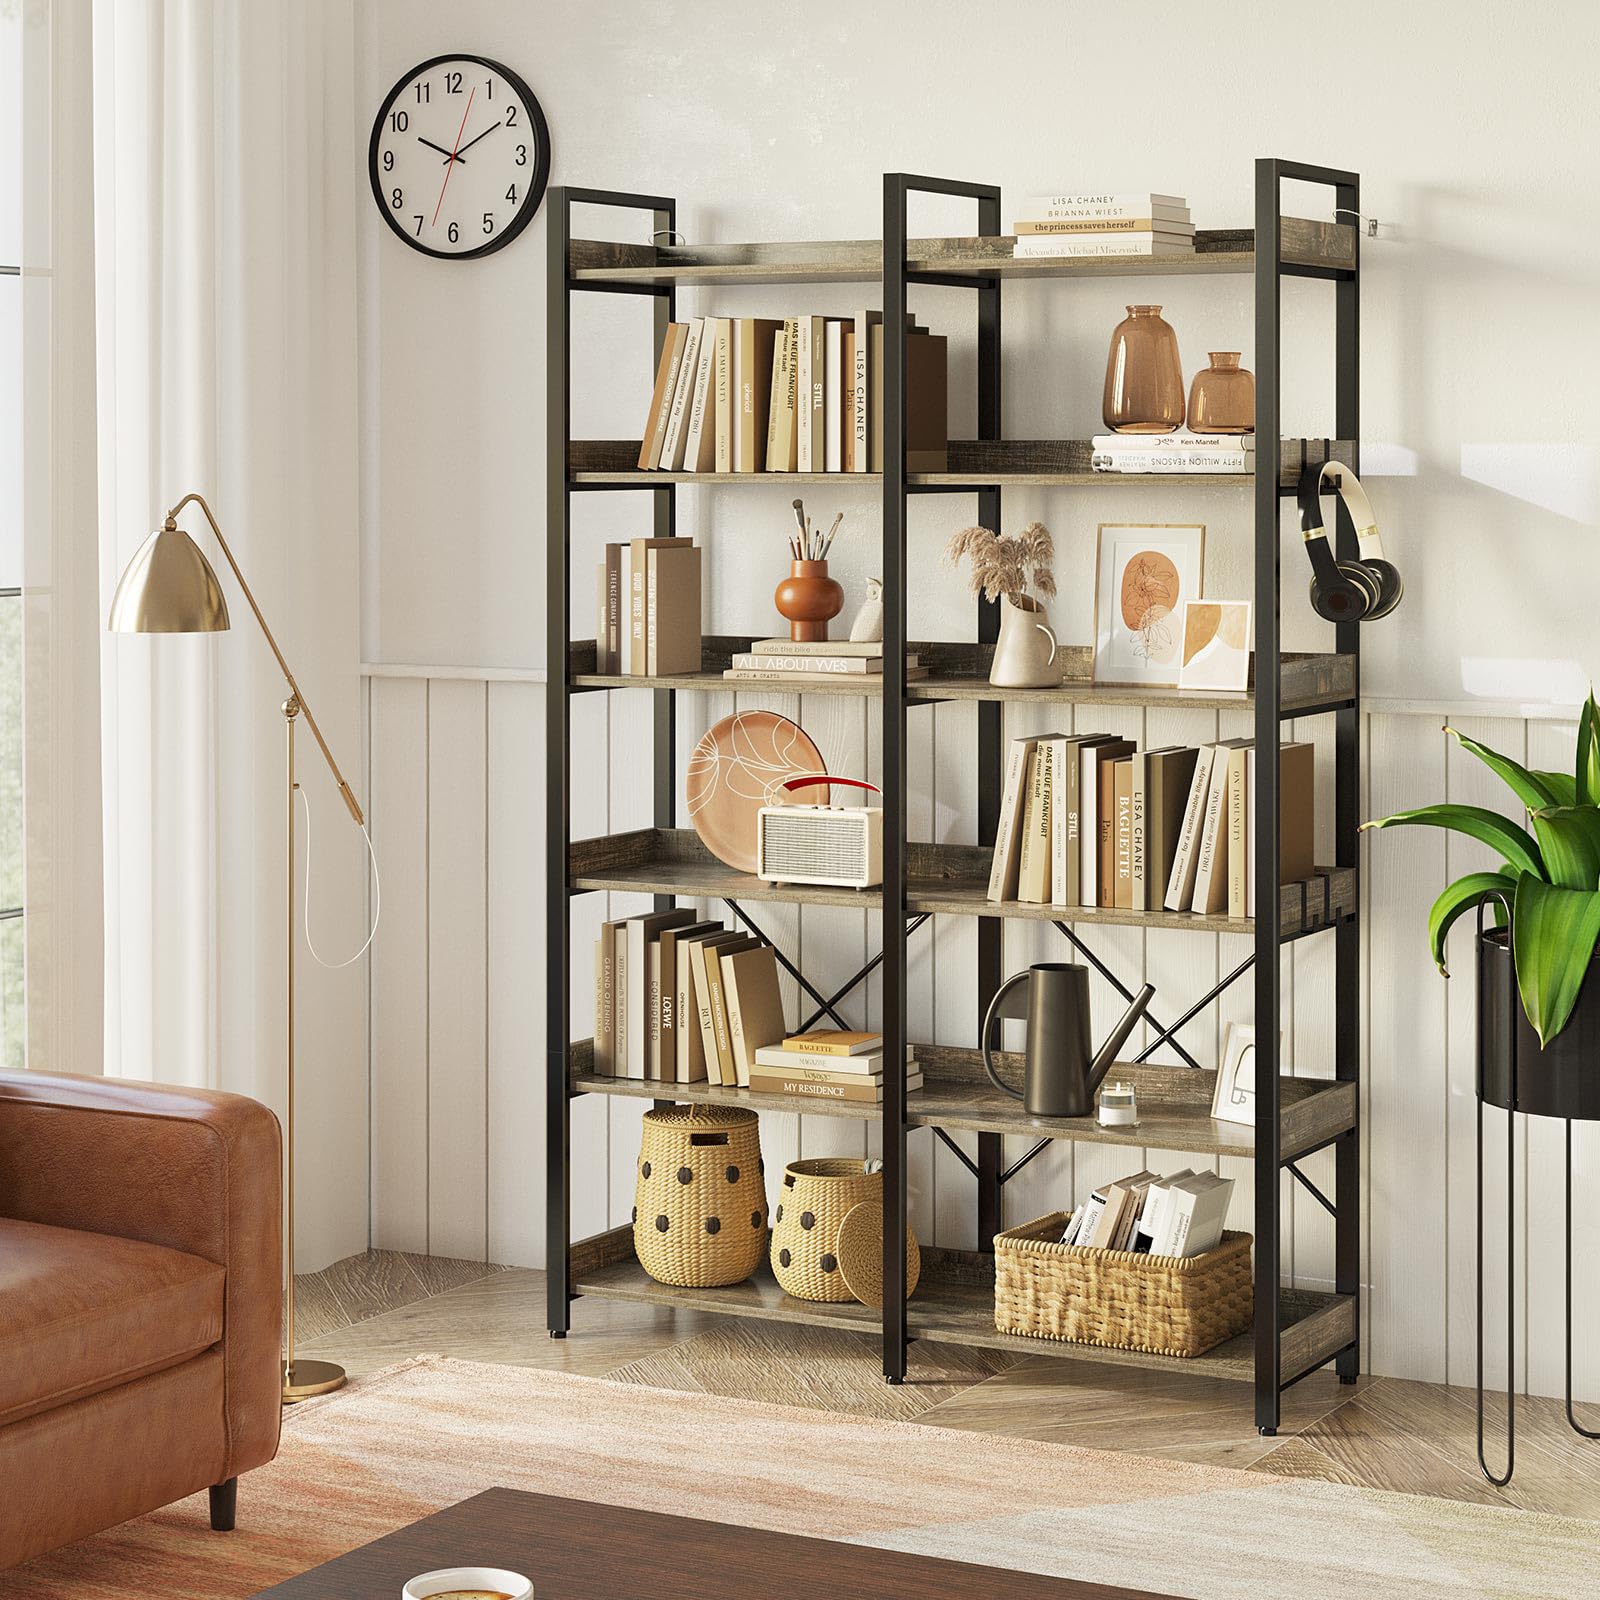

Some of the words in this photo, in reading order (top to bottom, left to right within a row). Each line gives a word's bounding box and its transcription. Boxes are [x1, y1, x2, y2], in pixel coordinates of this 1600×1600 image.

[414, 82, 430, 103] 11
[444, 72, 463, 93] 12
[485, 78, 492, 100] 1
[389, 111, 409, 132] 10
[505, 106, 517, 127] 2
[383, 151, 394, 171] 9
[515, 145, 526, 166] 3
[392, 188, 403, 209] 8
[505, 184, 517, 205] 4
[1052, 197, 1073, 205] LISA
[1077, 196, 1114, 204] CHANEY
[482, 213, 493, 234] 5
[1049, 210, 1091, 218] BRIANNA
[1095, 208, 1123, 216] WIEST
[414, 216, 424, 236] 7
[448, 222, 459, 243] 6
[1049, 222, 1084, 232] princess
[1084, 222, 1105, 230] saves
[1106, 220, 1135, 229] herself
[790, 321, 799, 339] DAS
[684, 334, 698, 362] lifestyle
[719, 337, 725, 351] ON
[781, 333, 789, 352] neue
[789, 340, 798, 362] NEUE
[780, 353, 788, 372] stadt
[856, 350, 864, 379] LISA
[663, 378, 675, 401] GOOD
[676, 361, 691, 400] sustainable
[786, 363, 796, 410] FRANKFURT
[812, 382, 822, 410] STILL
[845, 388, 855, 411] Paris
[673, 405, 681, 416] for
[690, 405, 702, 434] DREAM
[856, 387, 864, 442] CHANEY
[1151, 458, 1186, 466] REASONS
[1188, 458, 1220, 466] MILLION
[609, 569, 617, 596] TERENCE
[633, 572, 641, 591] GOOD
[633, 595, 641, 617] VIBES
[633, 621, 642, 639] ONLY
[739, 658, 761, 669] ALL
[766, 659, 810, 671] ABOUT
[816, 659, 848, 672] YVES
[1042, 765, 1051, 789] NEUE
[1193, 764, 1208, 794] lifestyle
[1233, 770, 1240, 784] ON
[1040, 790, 1050, 838] FRANKFURT
[1134, 792, 1142, 820] LISA
[1184, 793, 1200, 834] sustainable
[1232, 788, 1240, 842] IMMUNITY
[1067, 811, 1077, 840] STILL
[1101, 819, 1111, 842] Paris
[1201, 841, 1212, 873] DREAM
[1209, 788, 1220, 816] AWAKE
[1119, 796, 1129, 879] BAGUETTE
[1180, 840, 1189, 852] for
[1134, 827, 1142, 881] CHANEY
[650, 980, 658, 1040] CONSIDERED
[663, 996, 672, 1029] LOEWE
[799, 1044, 833, 1053] BAGUETTE
[803, 1071, 831, 1081] Voyage
[784, 1082, 796, 1092] MY
[798, 1083, 845, 1097] RESIDENCE
